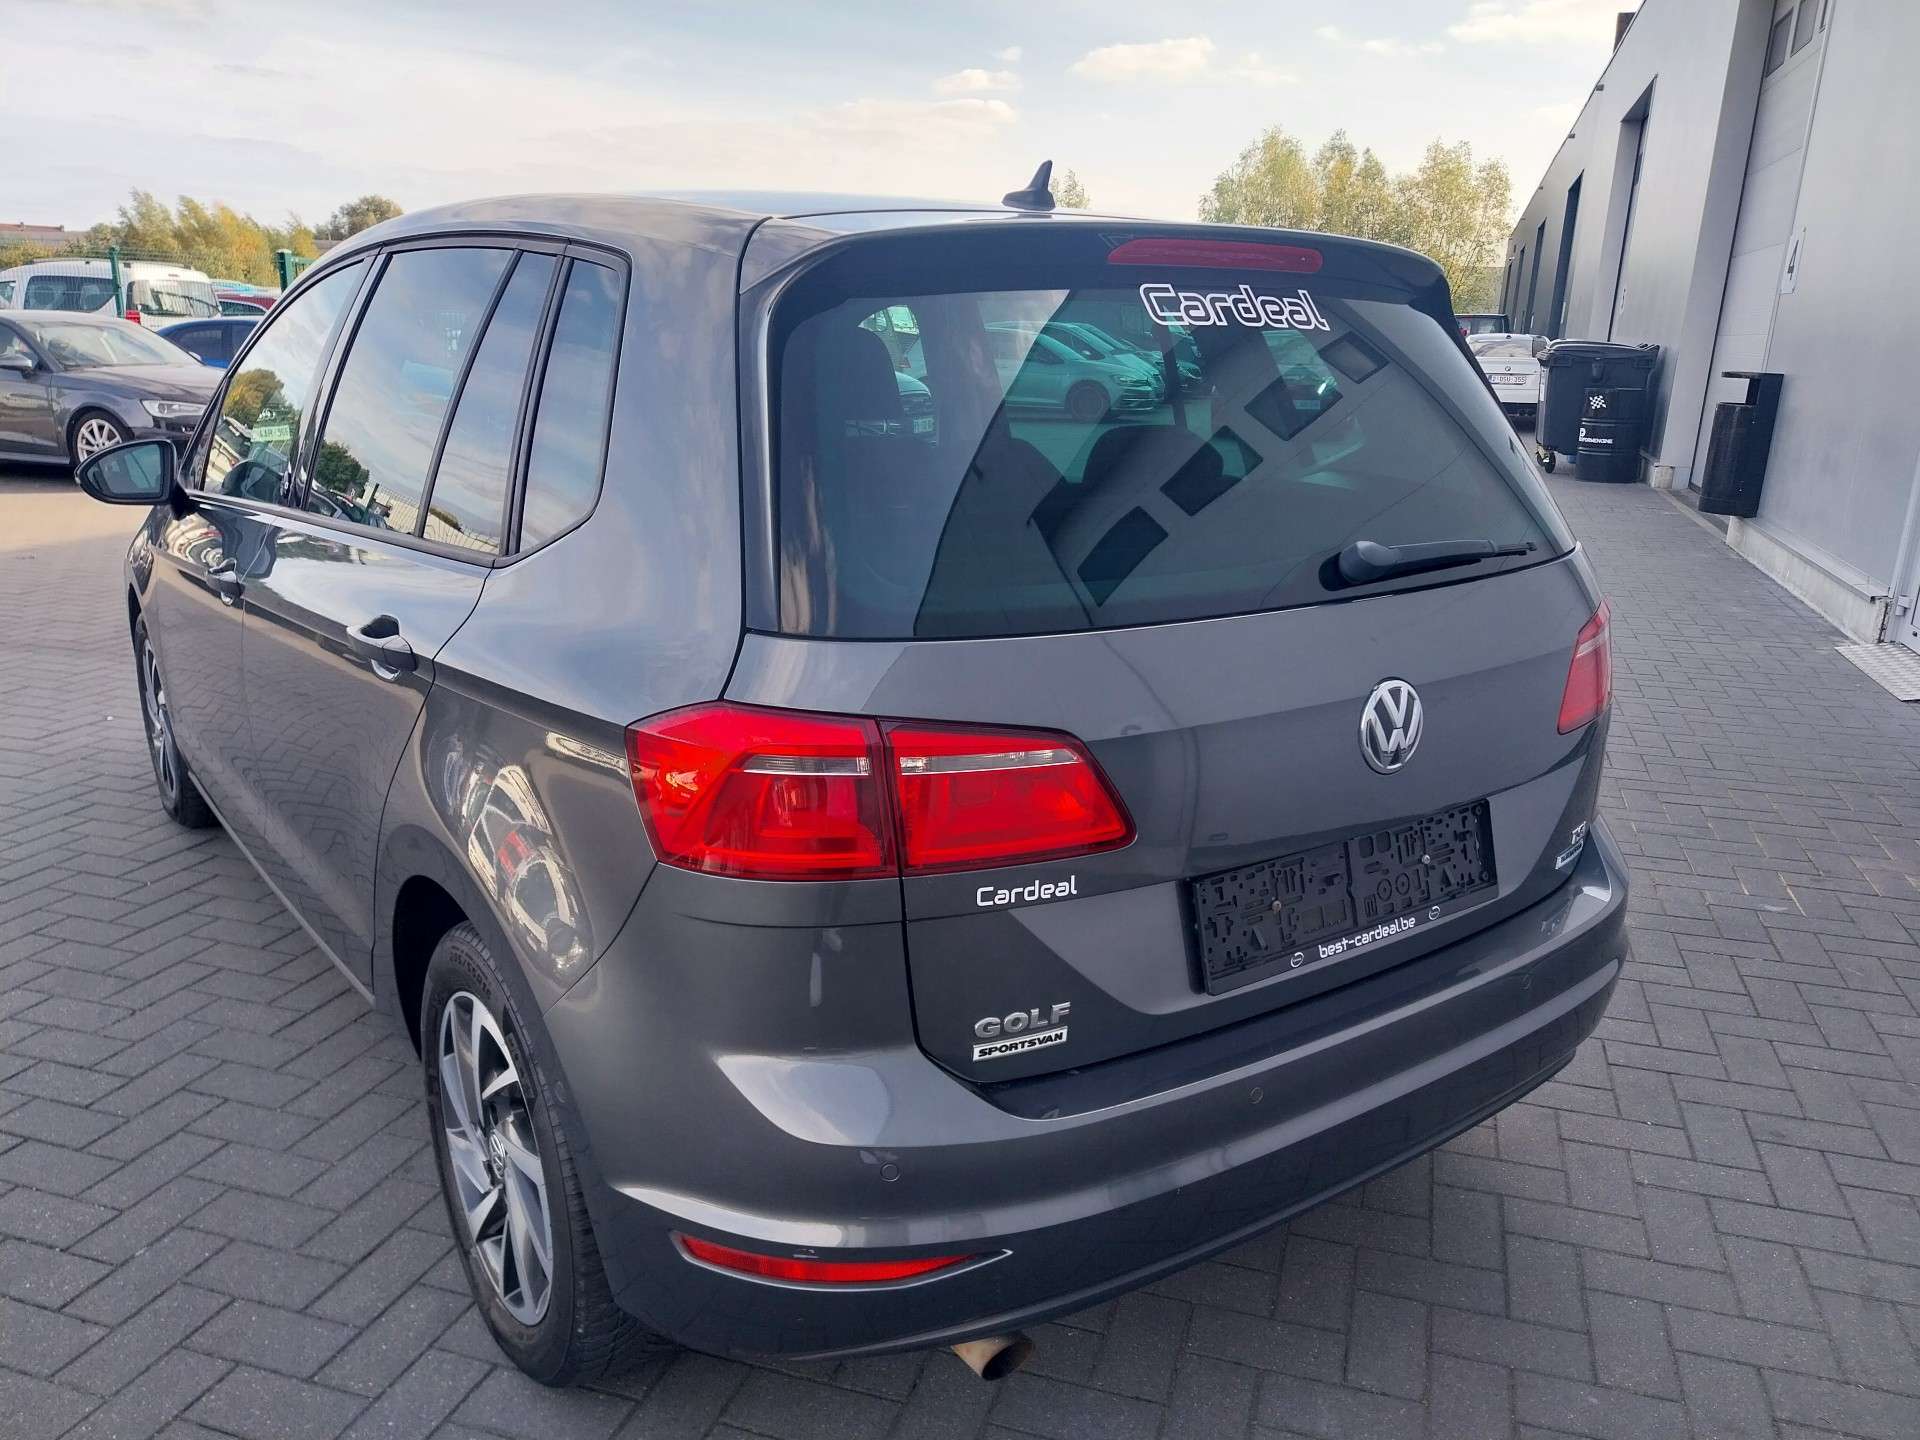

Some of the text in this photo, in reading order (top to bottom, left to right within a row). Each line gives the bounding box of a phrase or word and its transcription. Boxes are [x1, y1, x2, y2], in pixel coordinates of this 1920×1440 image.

[1787, 240, 1799, 281] 4
[1139, 283, 1331, 331] Cardeal
[976, 875, 1078, 907] Cardeal
[1318, 916, 1416, 959] best-cardeal.be
[974, 1001, 1071, 1039] GOLF
[978, 1032, 1064, 1058] SPORTSVAN
